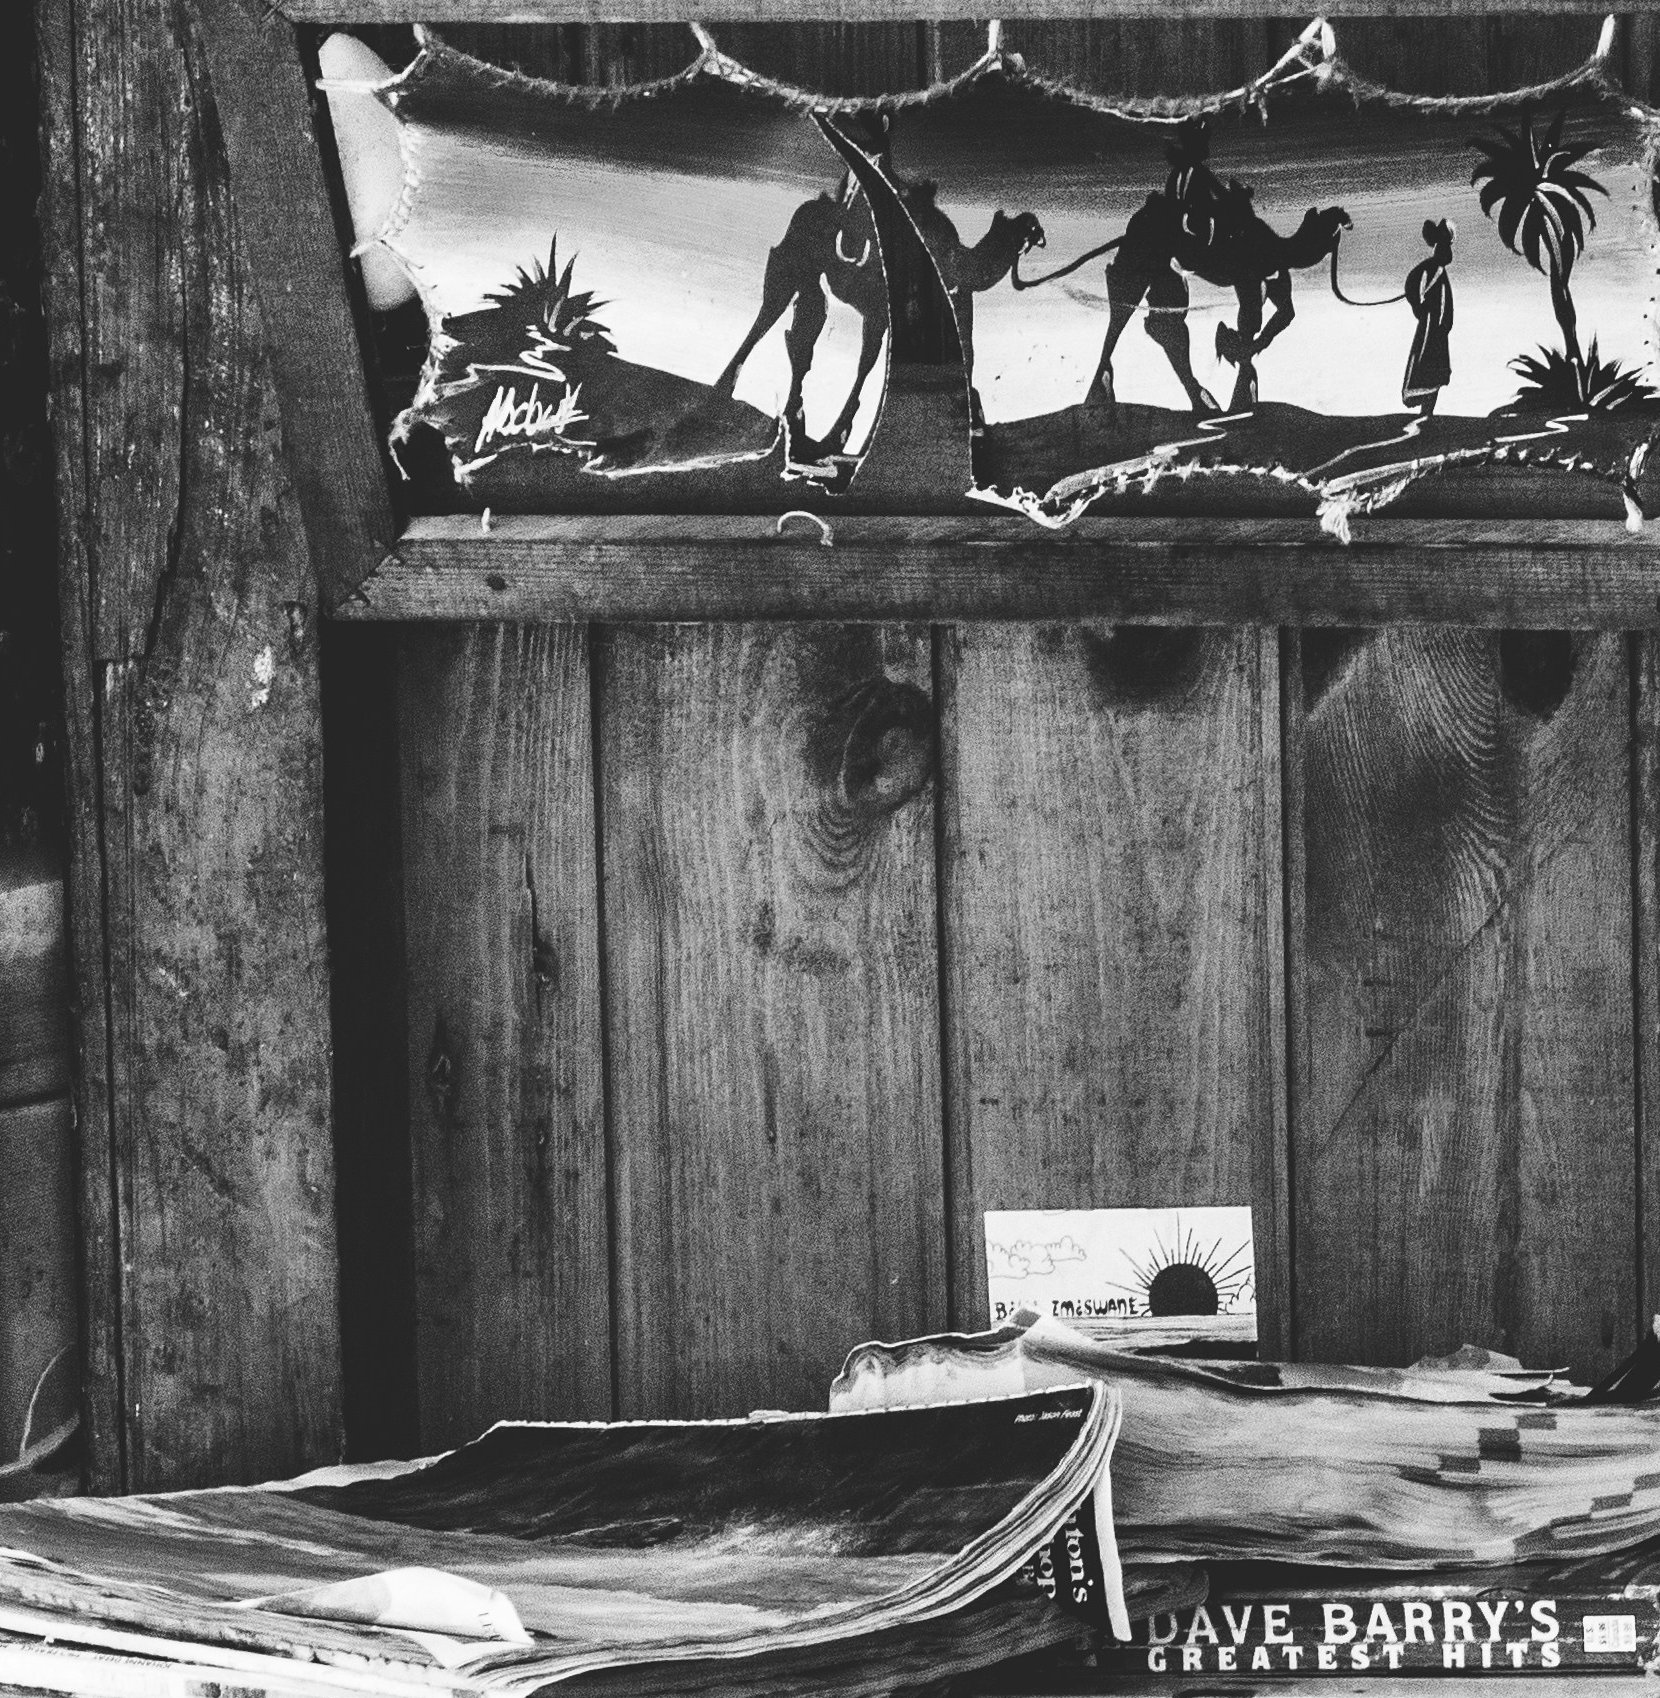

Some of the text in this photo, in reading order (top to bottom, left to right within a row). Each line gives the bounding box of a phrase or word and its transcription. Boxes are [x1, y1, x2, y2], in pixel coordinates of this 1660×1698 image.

[1148, 1604, 1294, 1645] DAVE
[1323, 1600, 1560, 1645] BARRY'S
[1147, 1641, 1561, 1672] GREATEST HITS
